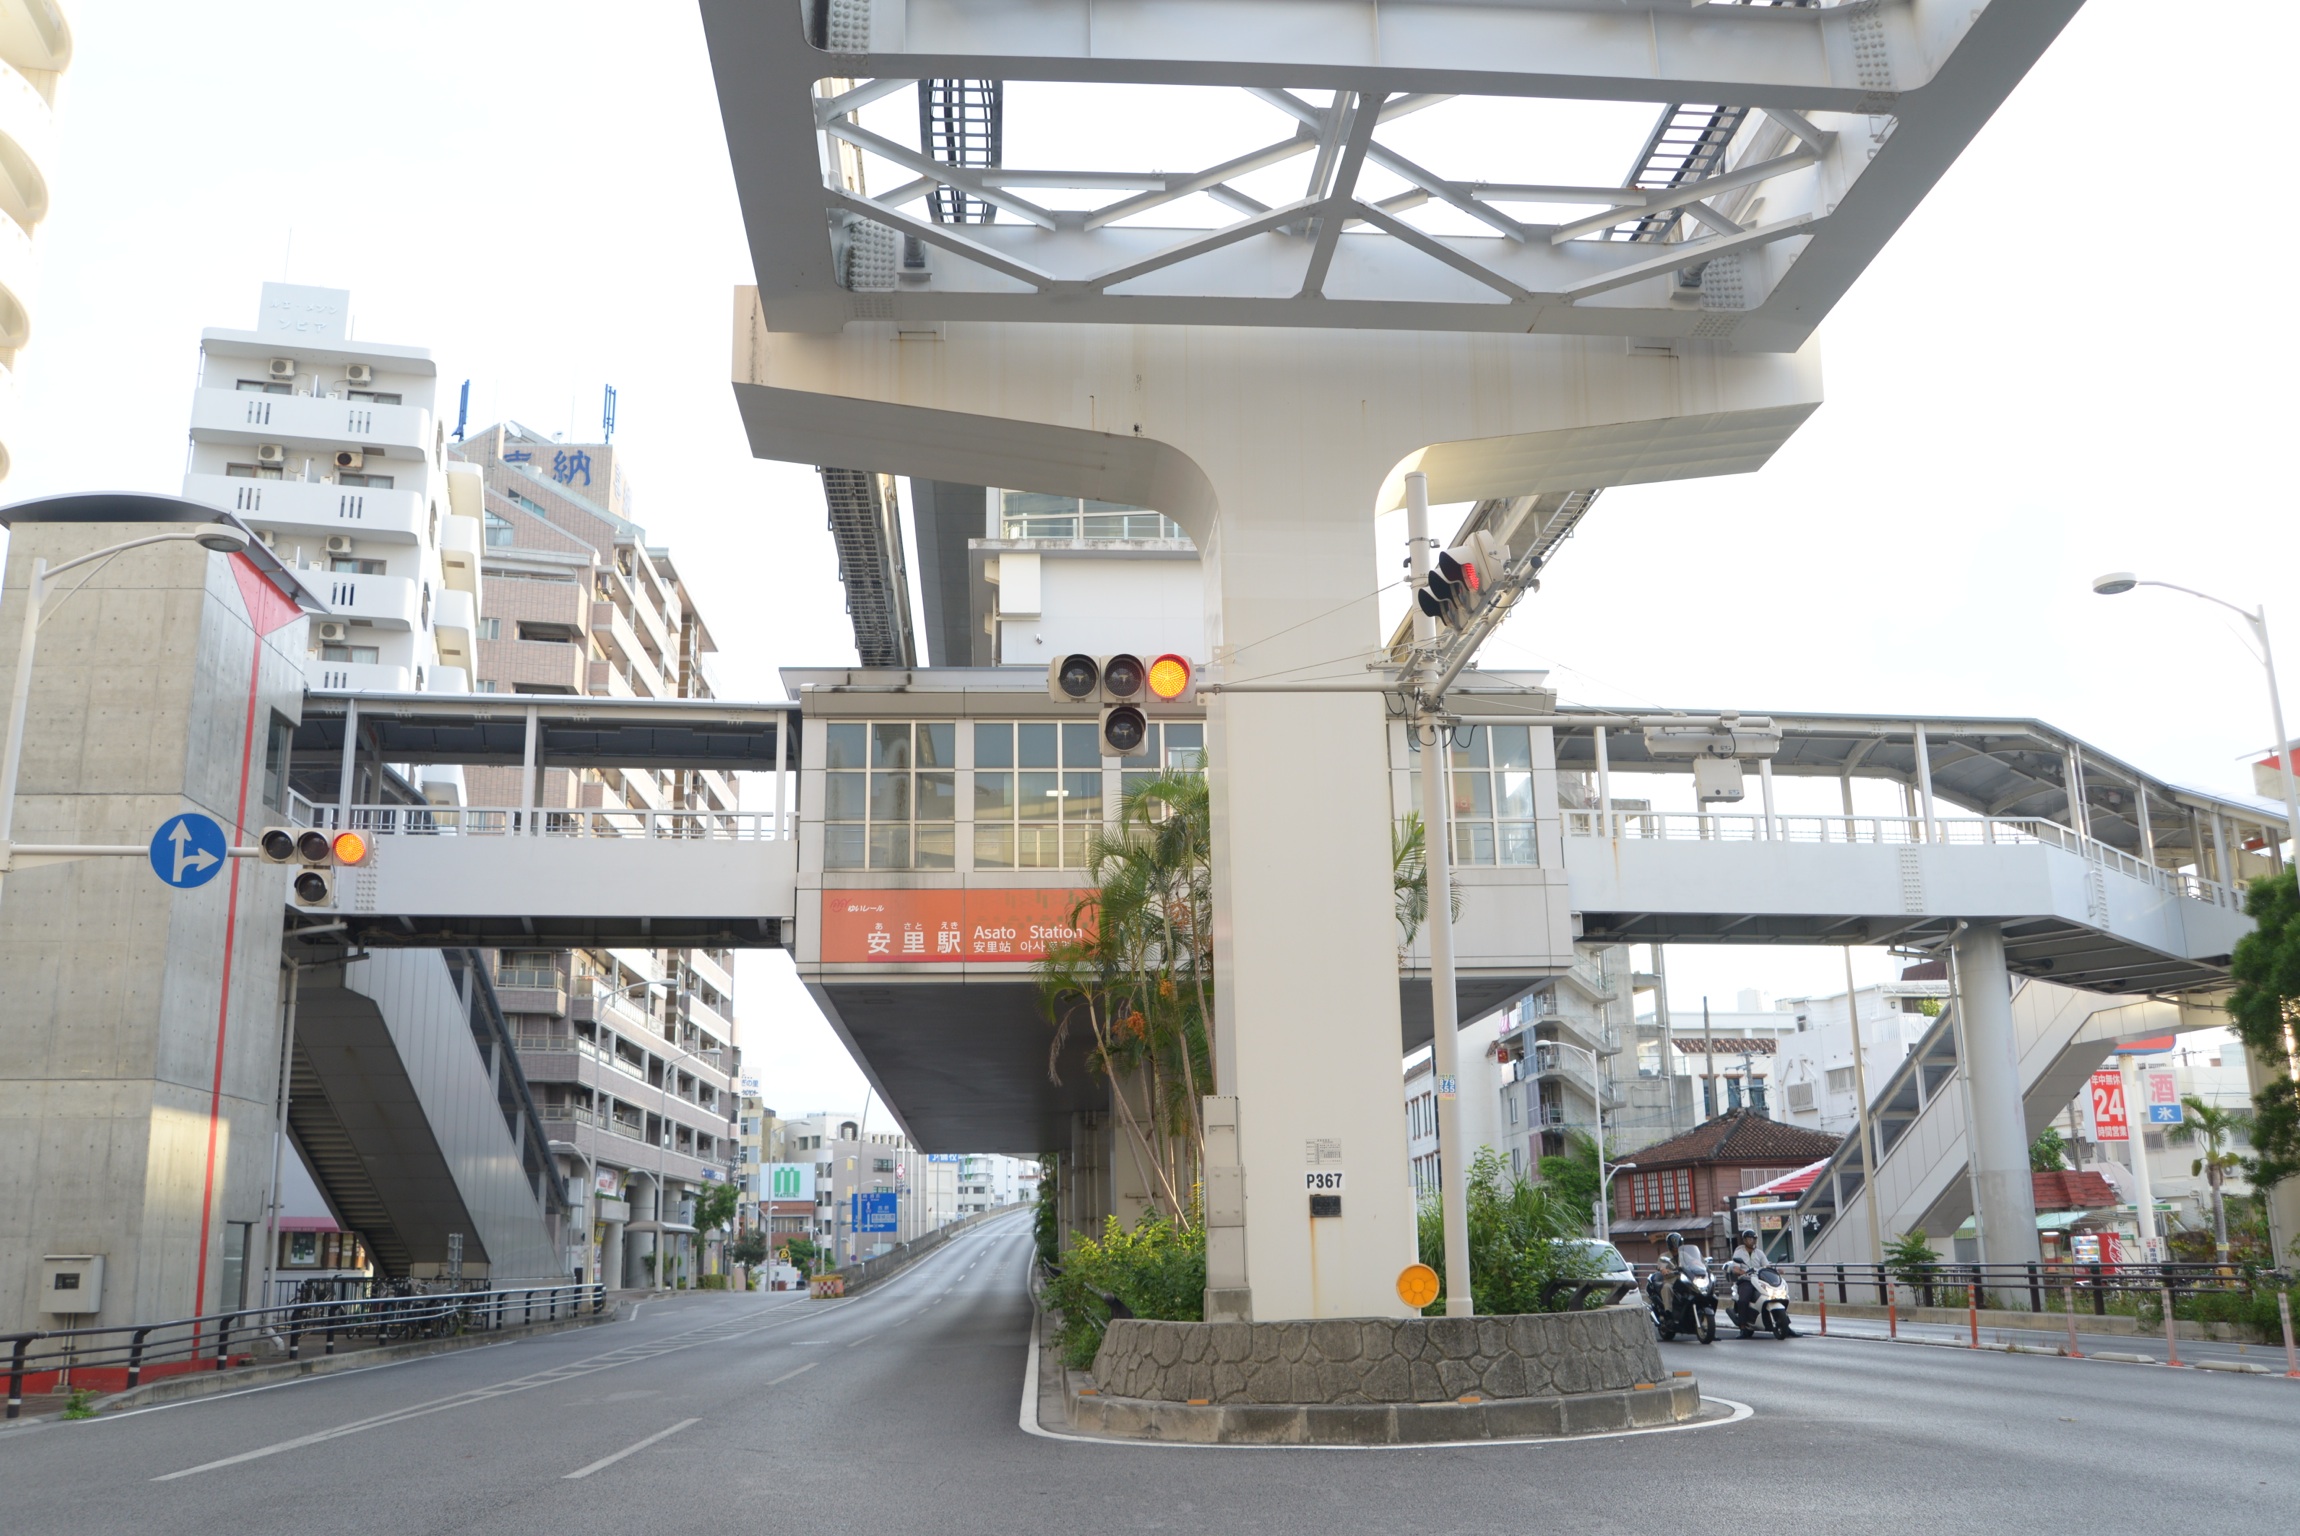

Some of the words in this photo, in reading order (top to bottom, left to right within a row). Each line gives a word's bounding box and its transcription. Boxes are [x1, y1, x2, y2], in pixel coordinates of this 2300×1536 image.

[847, 904, 885, 913] ゆいレール
[973, 925, 1016, 939] Asato
[1030, 924, 1083, 939] Station
[867, 931, 961, 954] 安里駅
[973, 941, 1011, 953] 安里站
[2091, 1074, 2121, 1086] 年中無休
[2148, 1073, 2175, 1103] 酒
[2093, 1088, 2124, 1122] 24
[2097, 1125, 2128, 1138] 時間営業
[1306, 1173, 1342, 1189] P367
